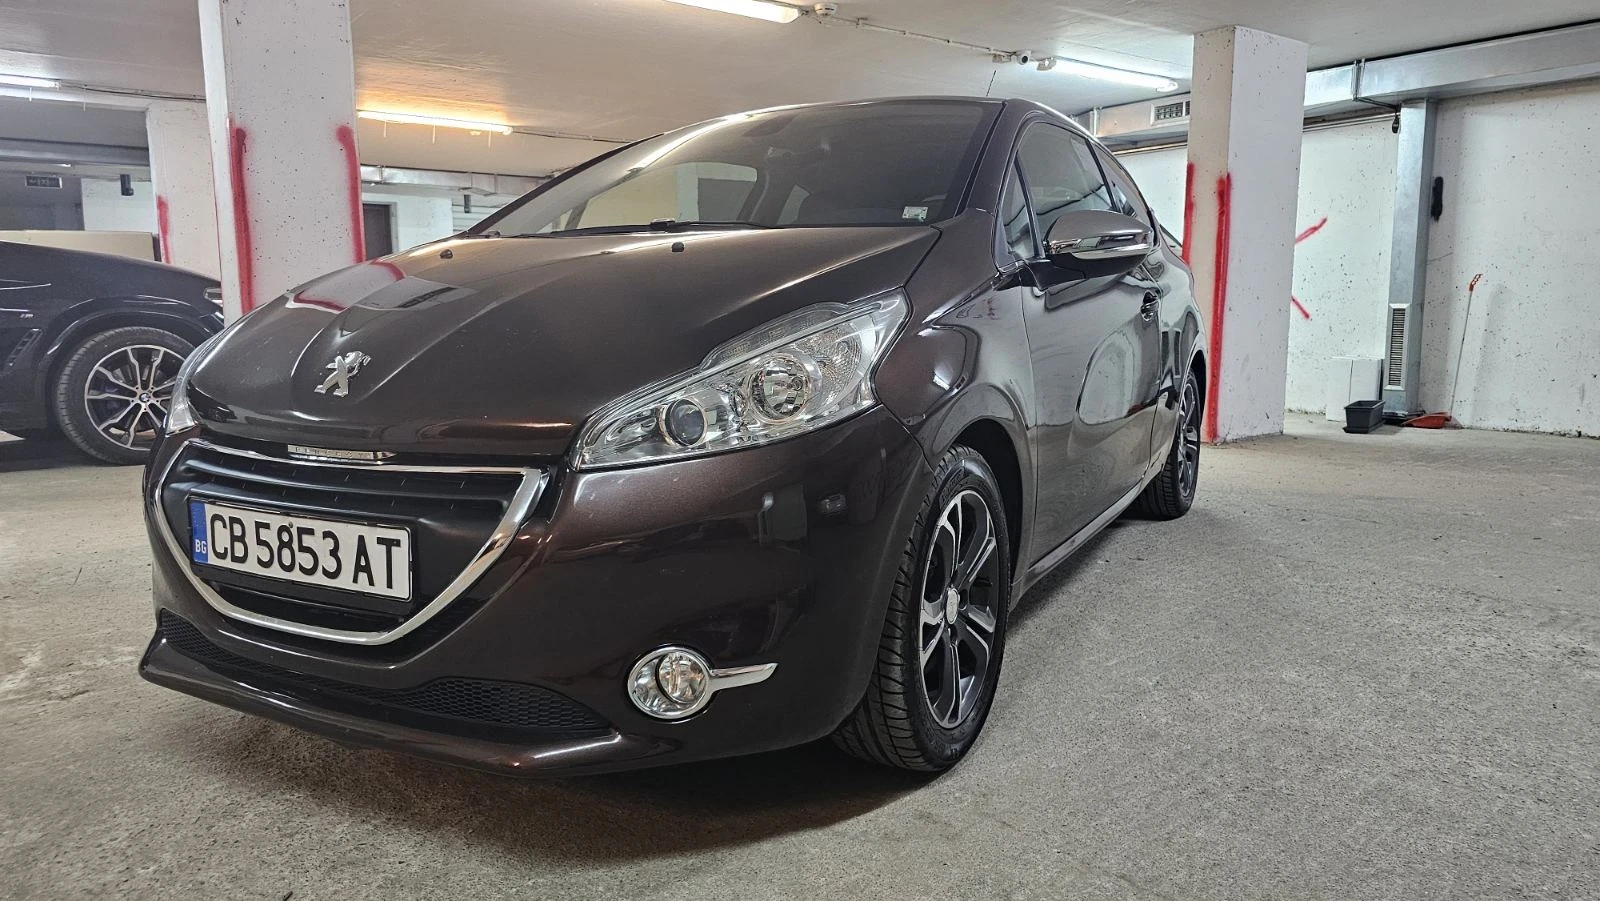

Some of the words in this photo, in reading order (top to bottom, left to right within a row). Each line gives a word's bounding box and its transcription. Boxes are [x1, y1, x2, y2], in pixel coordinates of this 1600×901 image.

[195, 540, 207, 553] BG
[210, 514, 248, 563] CB
[255, 521, 342, 579] 5853
[352, 535, 401, 589] AT
